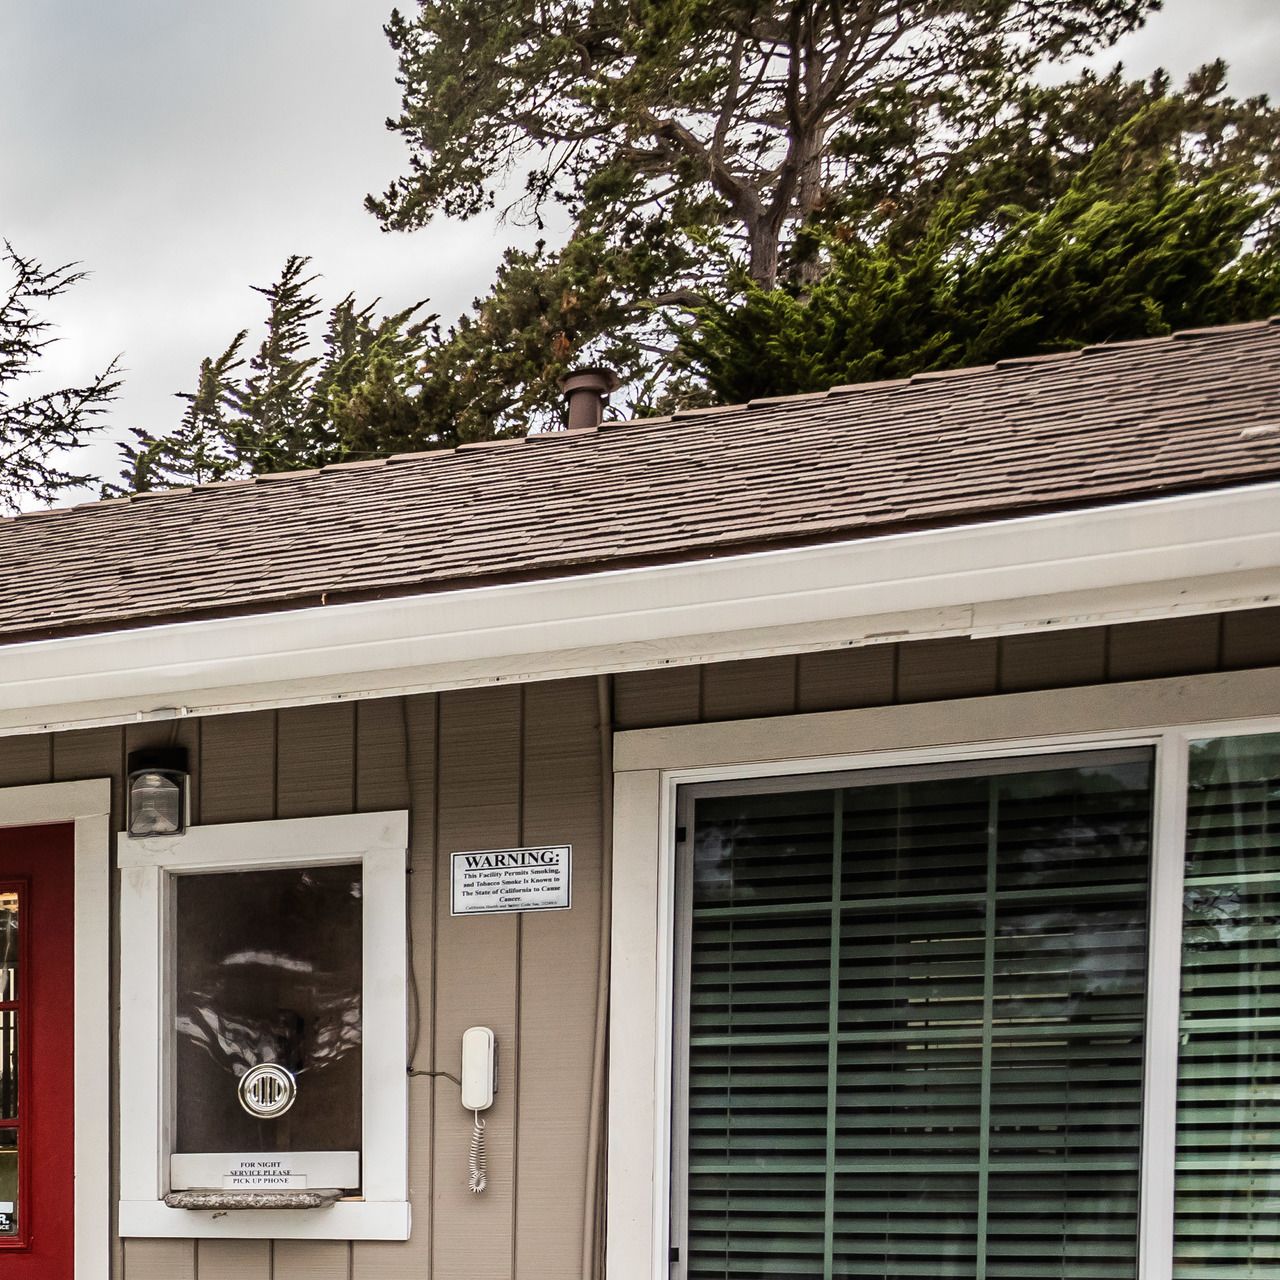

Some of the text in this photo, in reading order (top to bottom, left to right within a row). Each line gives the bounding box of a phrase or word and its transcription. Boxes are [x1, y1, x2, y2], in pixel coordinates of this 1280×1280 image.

[464, 850, 560, 868] WARNING:
[479, 871, 502, 879] Facility
[504, 869, 529, 877] Permits
